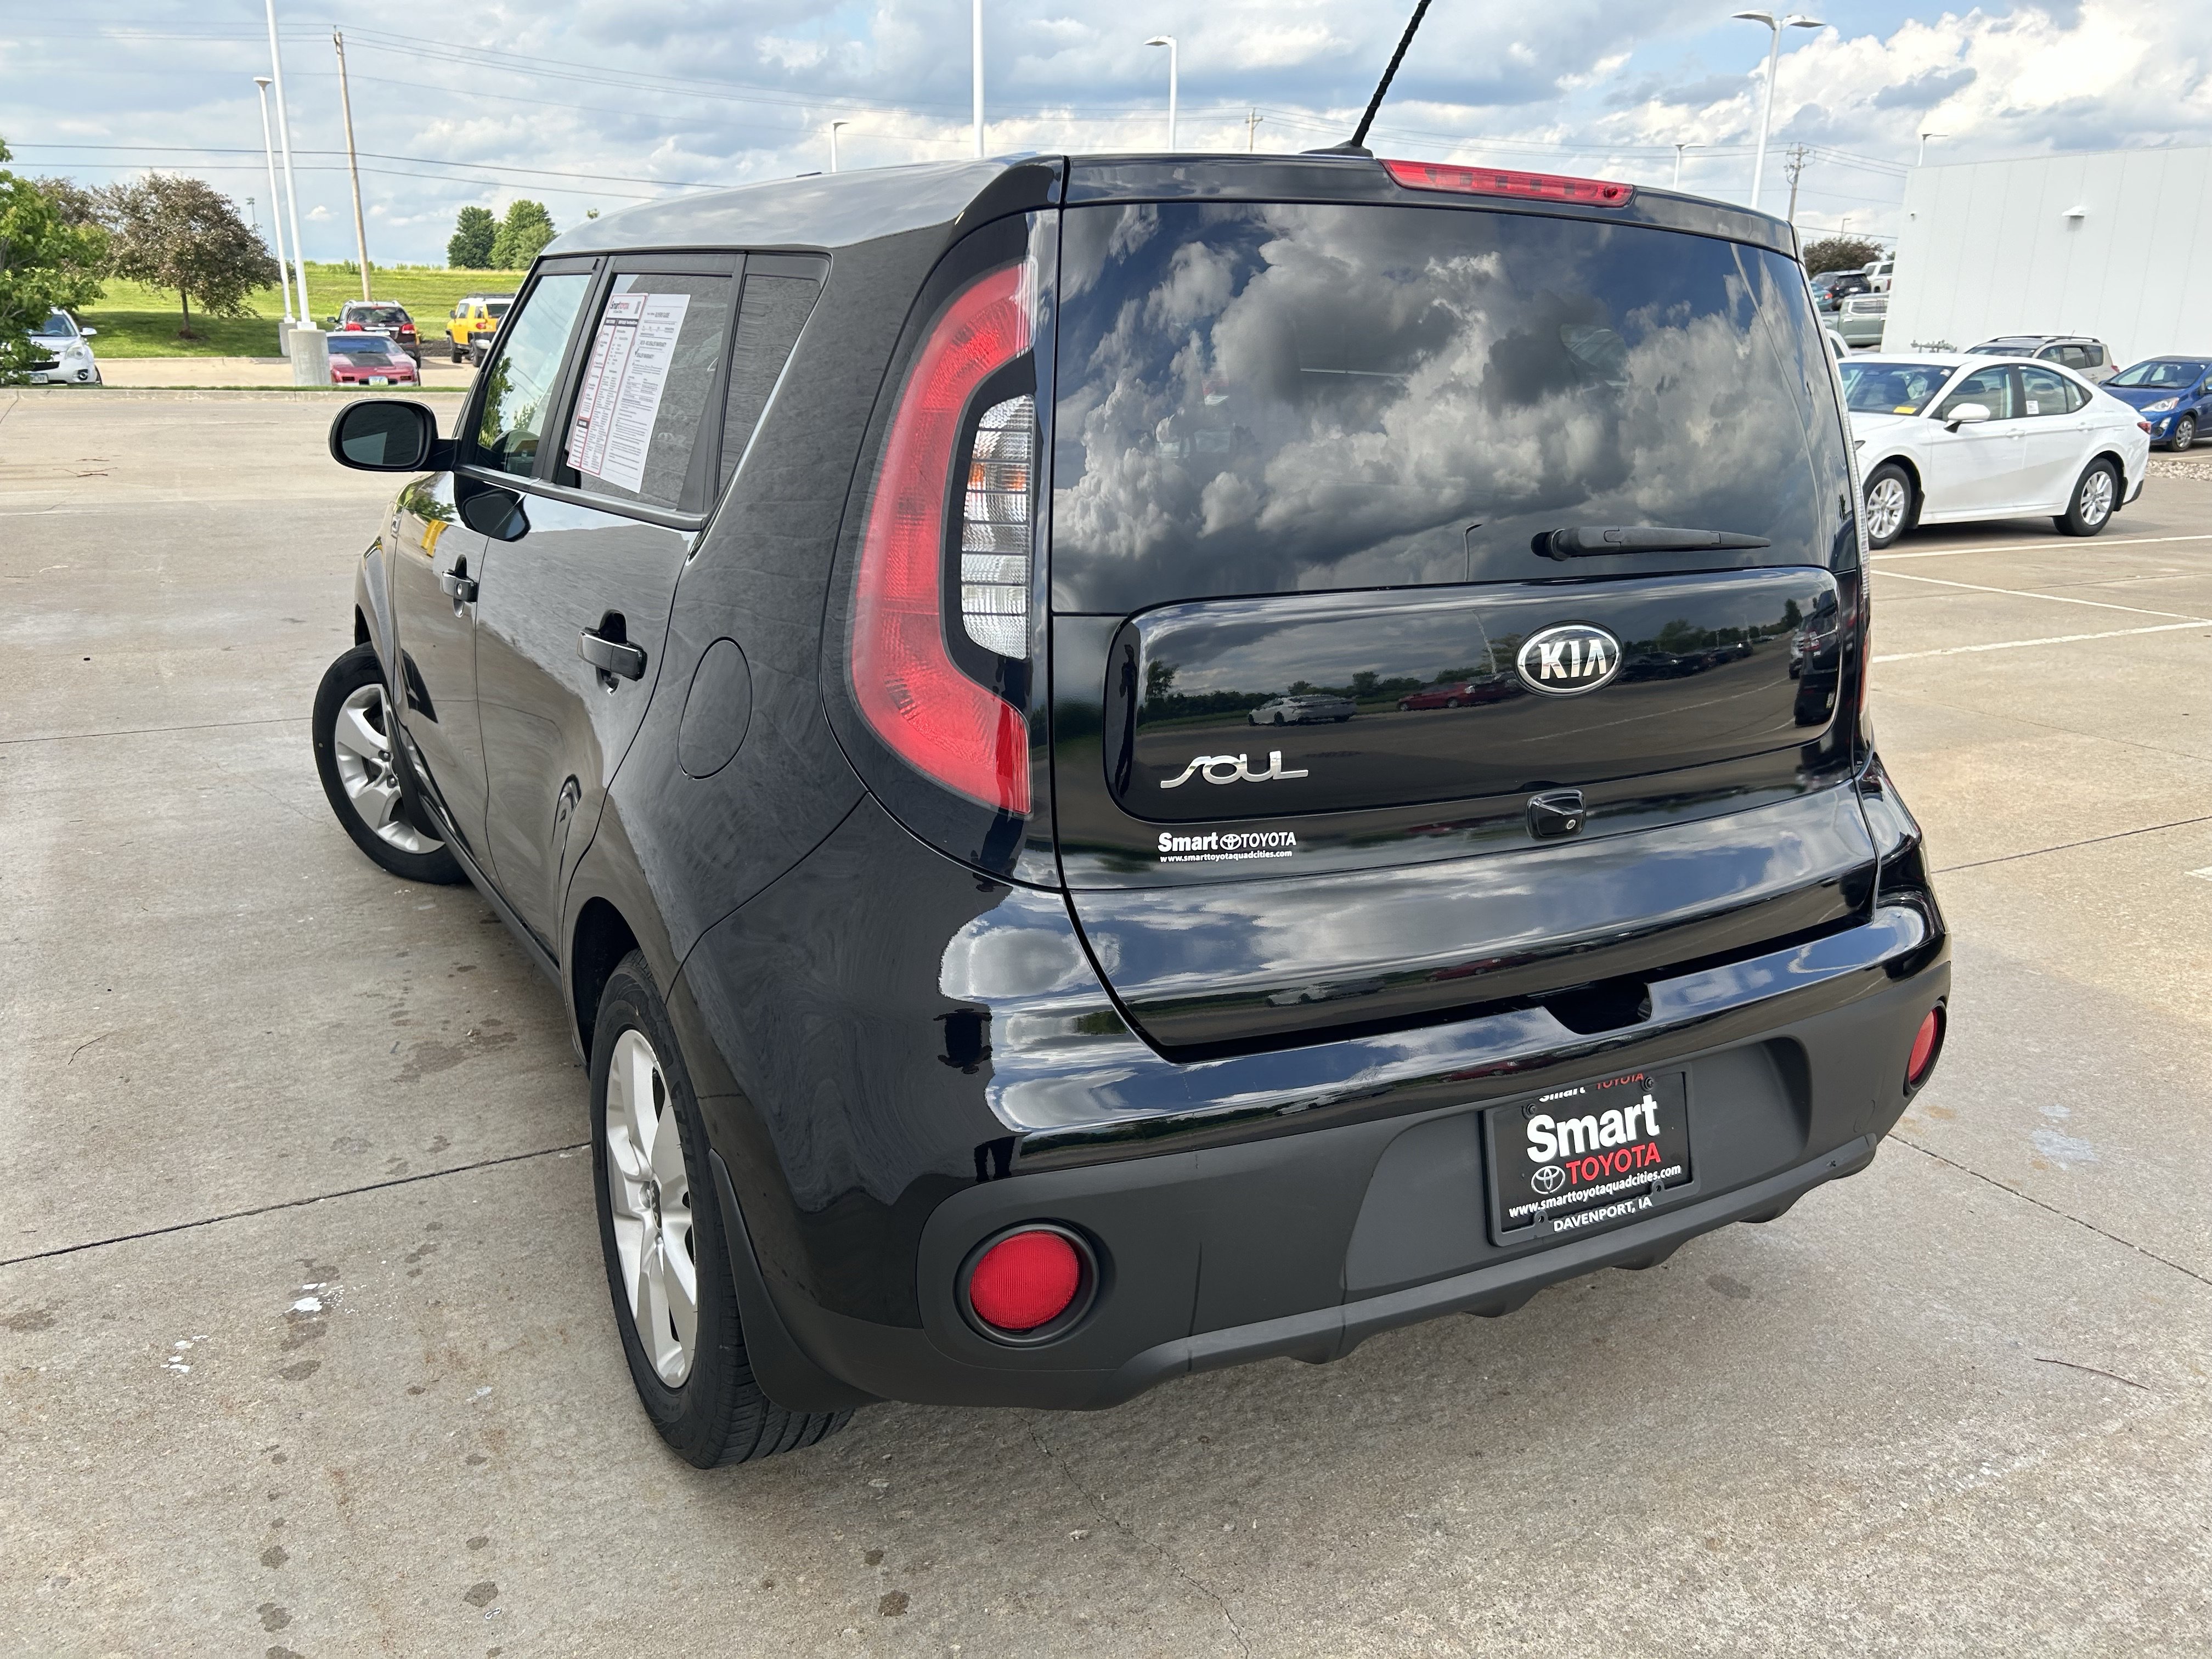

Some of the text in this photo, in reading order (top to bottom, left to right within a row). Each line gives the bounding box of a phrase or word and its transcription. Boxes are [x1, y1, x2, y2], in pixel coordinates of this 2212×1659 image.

[1538, 639, 1606, 679] KIA
[1158, 832, 1296, 852] Smart TOYOTA
[1160, 850, 1293, 862] www.smarttoyotaquadcities.com
[1527, 1094, 1660, 1163] Smart
[1566, 1142, 1661, 1184] TOYOTA
[1509, 1164, 1681, 1218] www.smarttoyotaquadcities.com
[1554, 1197, 1652, 1232] DAVENPORT, IA
